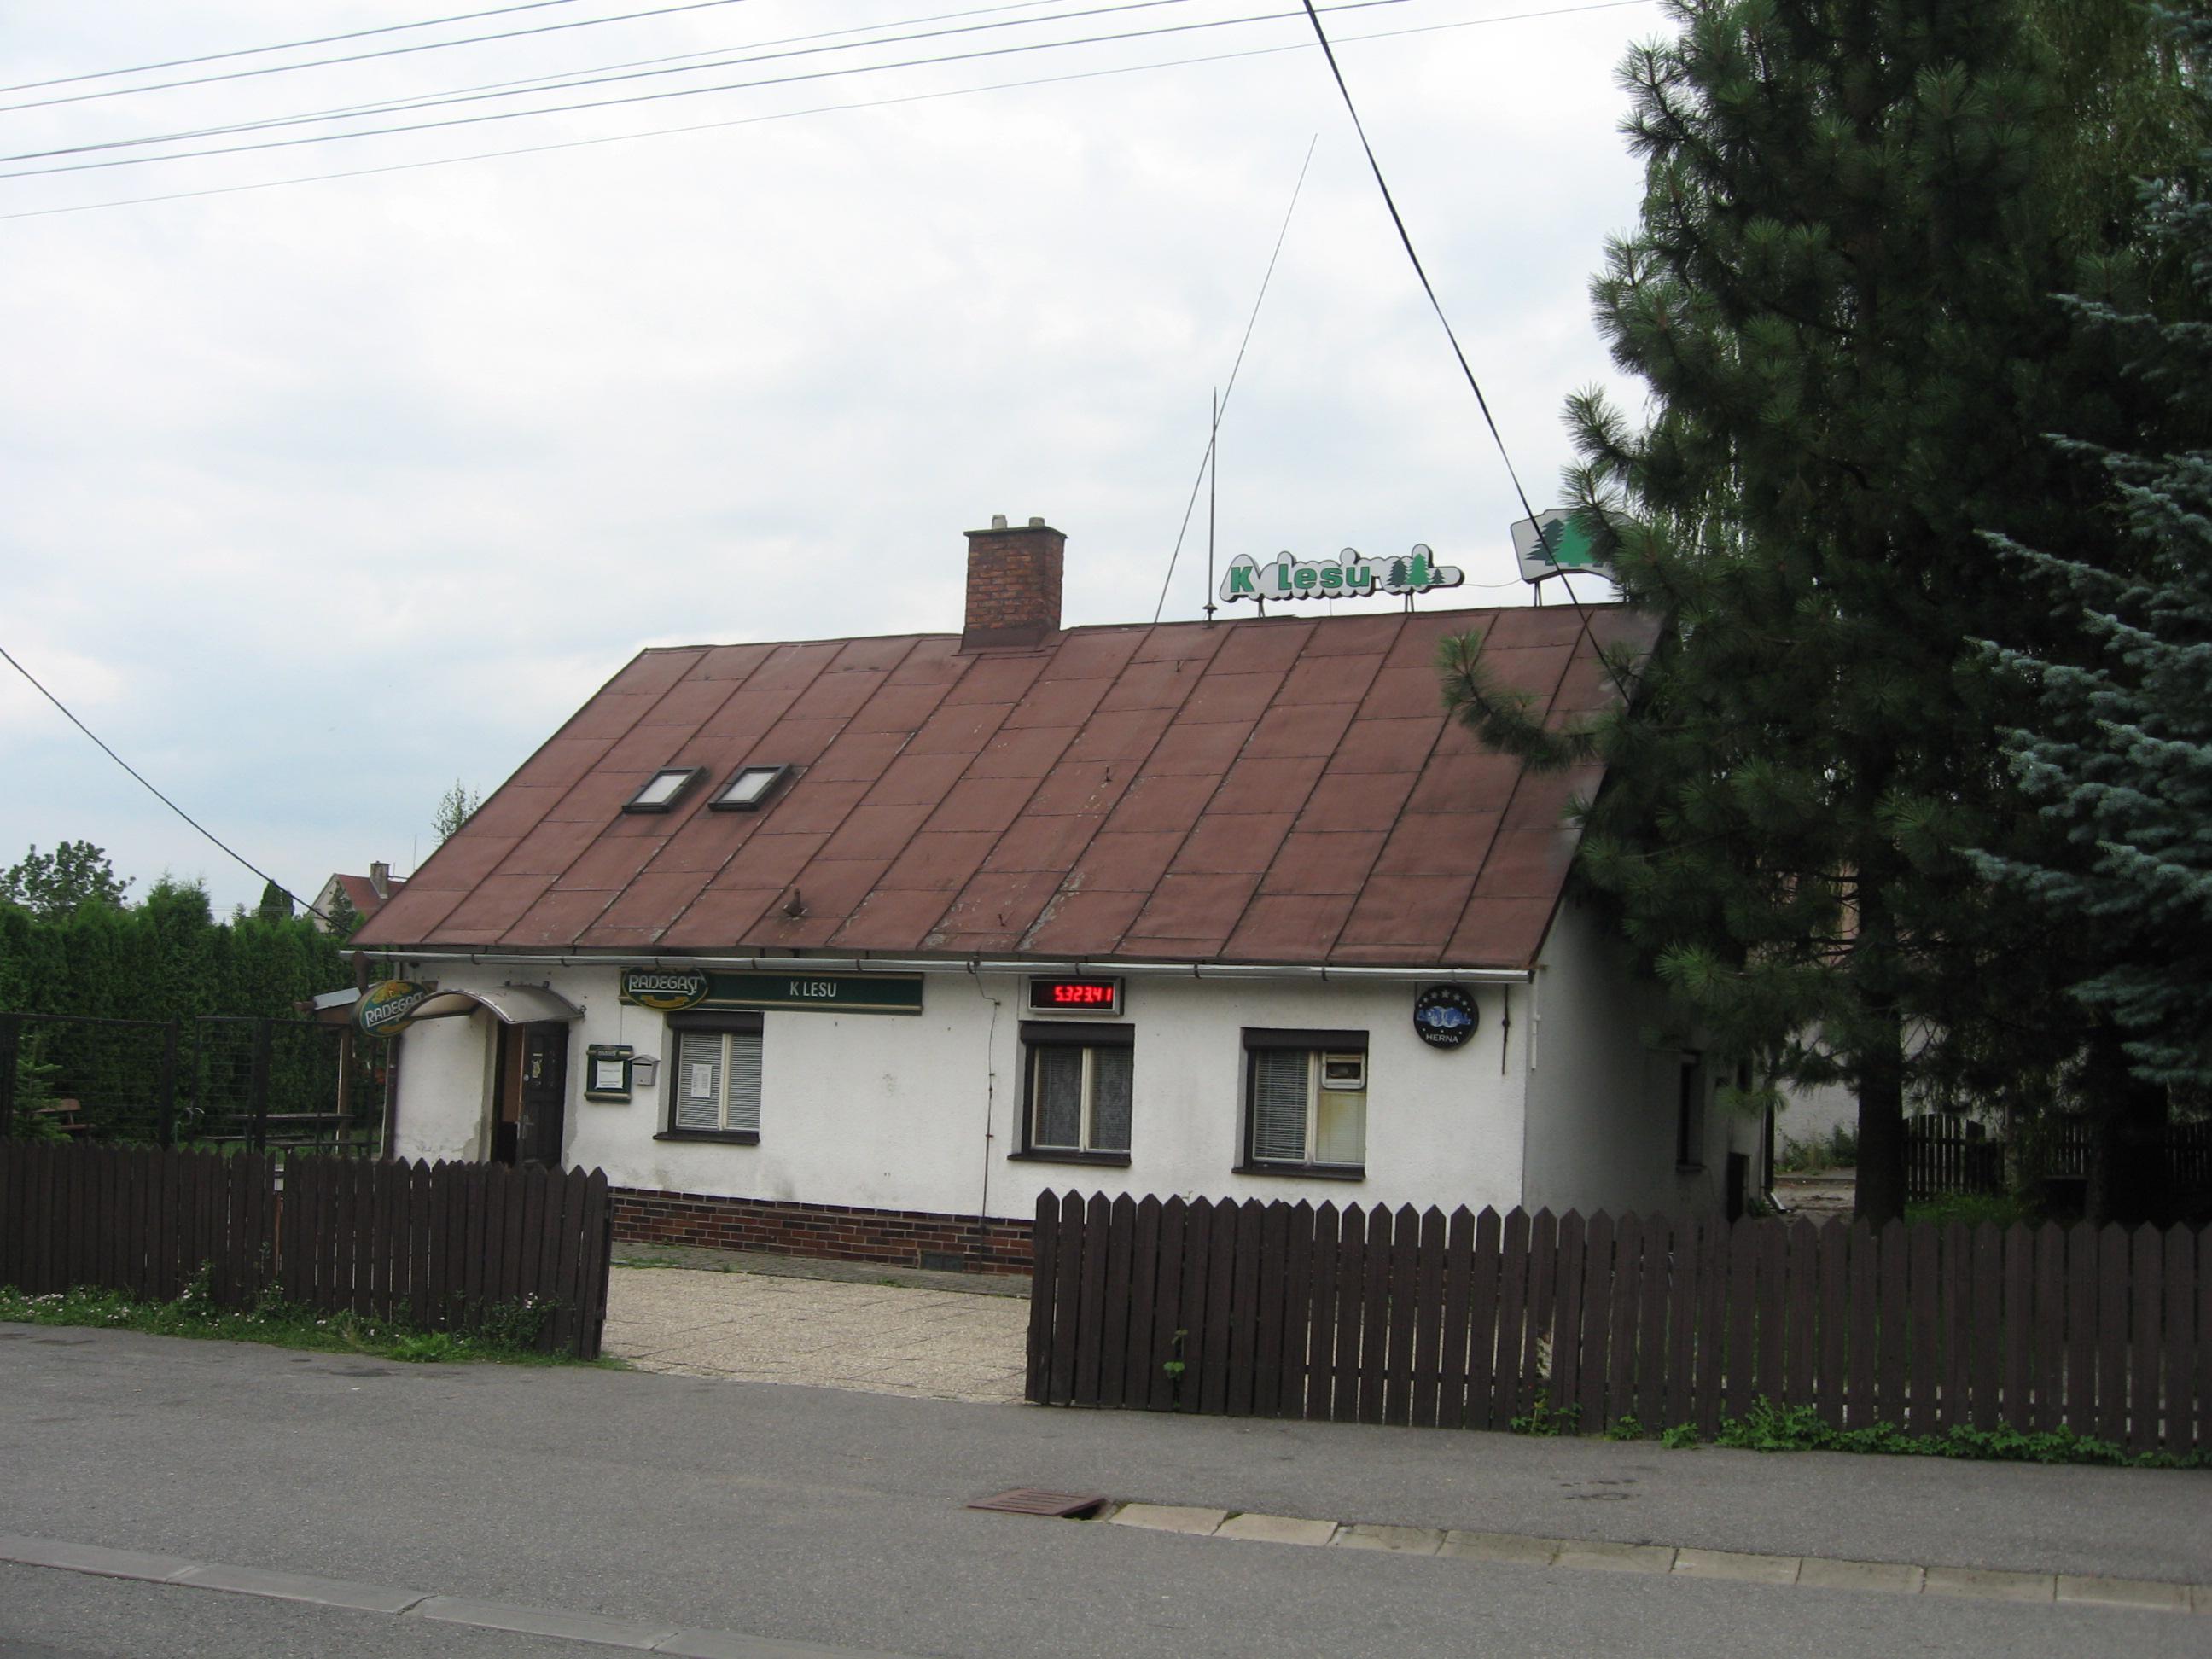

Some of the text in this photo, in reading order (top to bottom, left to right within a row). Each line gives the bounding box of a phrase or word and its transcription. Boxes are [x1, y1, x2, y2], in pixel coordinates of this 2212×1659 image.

[1230, 563, 1371, 593] K lesu
[628, 975, 703, 996] RADEGAST
[790, 981, 837, 997] K LESU
[1426, 1033, 1458, 1043] HERNA
